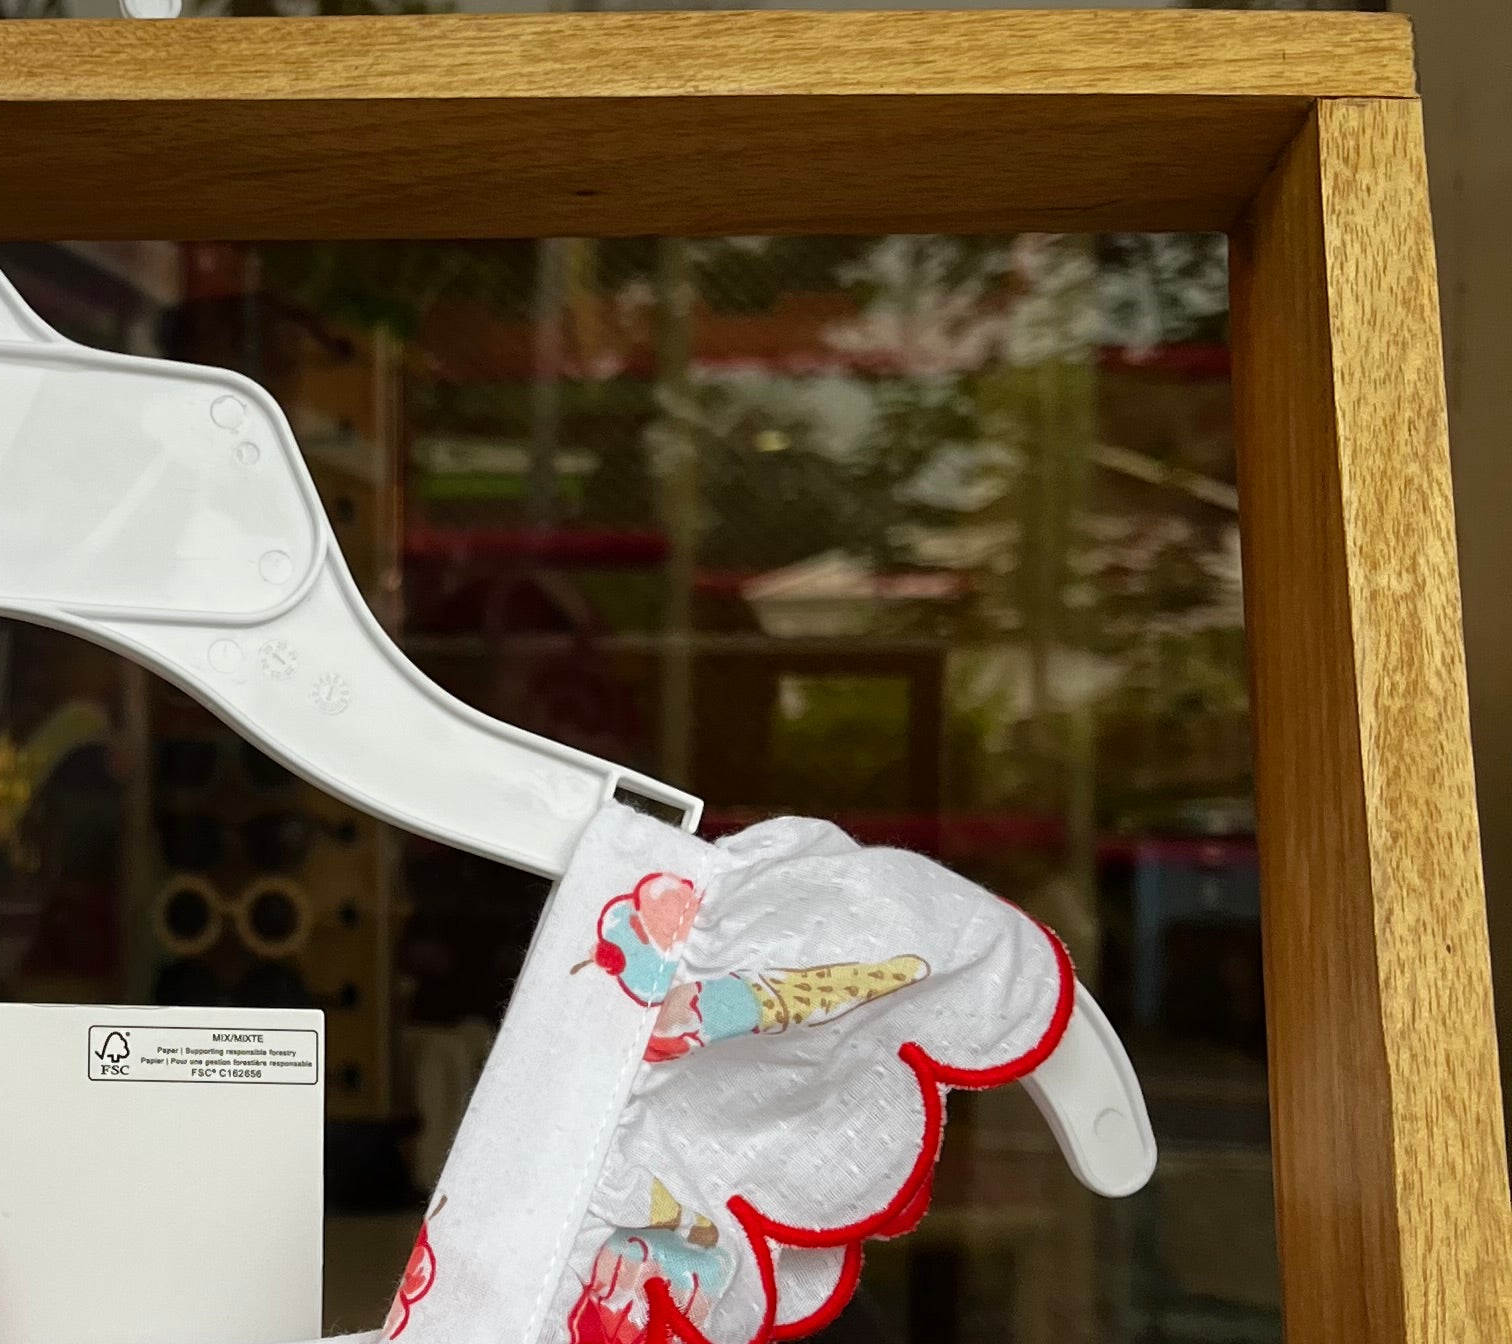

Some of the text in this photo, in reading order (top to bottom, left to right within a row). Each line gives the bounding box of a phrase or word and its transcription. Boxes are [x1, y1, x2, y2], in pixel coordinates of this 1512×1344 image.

[212, 1033, 264, 1043] MIX/MIXTE
[157, 1046, 179, 1055] Paper
[185, 1047, 224, 1057] Supporting
[226, 1048, 267, 1057] responsible
[269, 1049, 297, 1058] forestry
[140, 1056, 165, 1065] Papier
[205, 1059, 232, 1067] gestion
[269, 1060, 313, 1068] responsable
[100, 1064, 130, 1076] FSC
